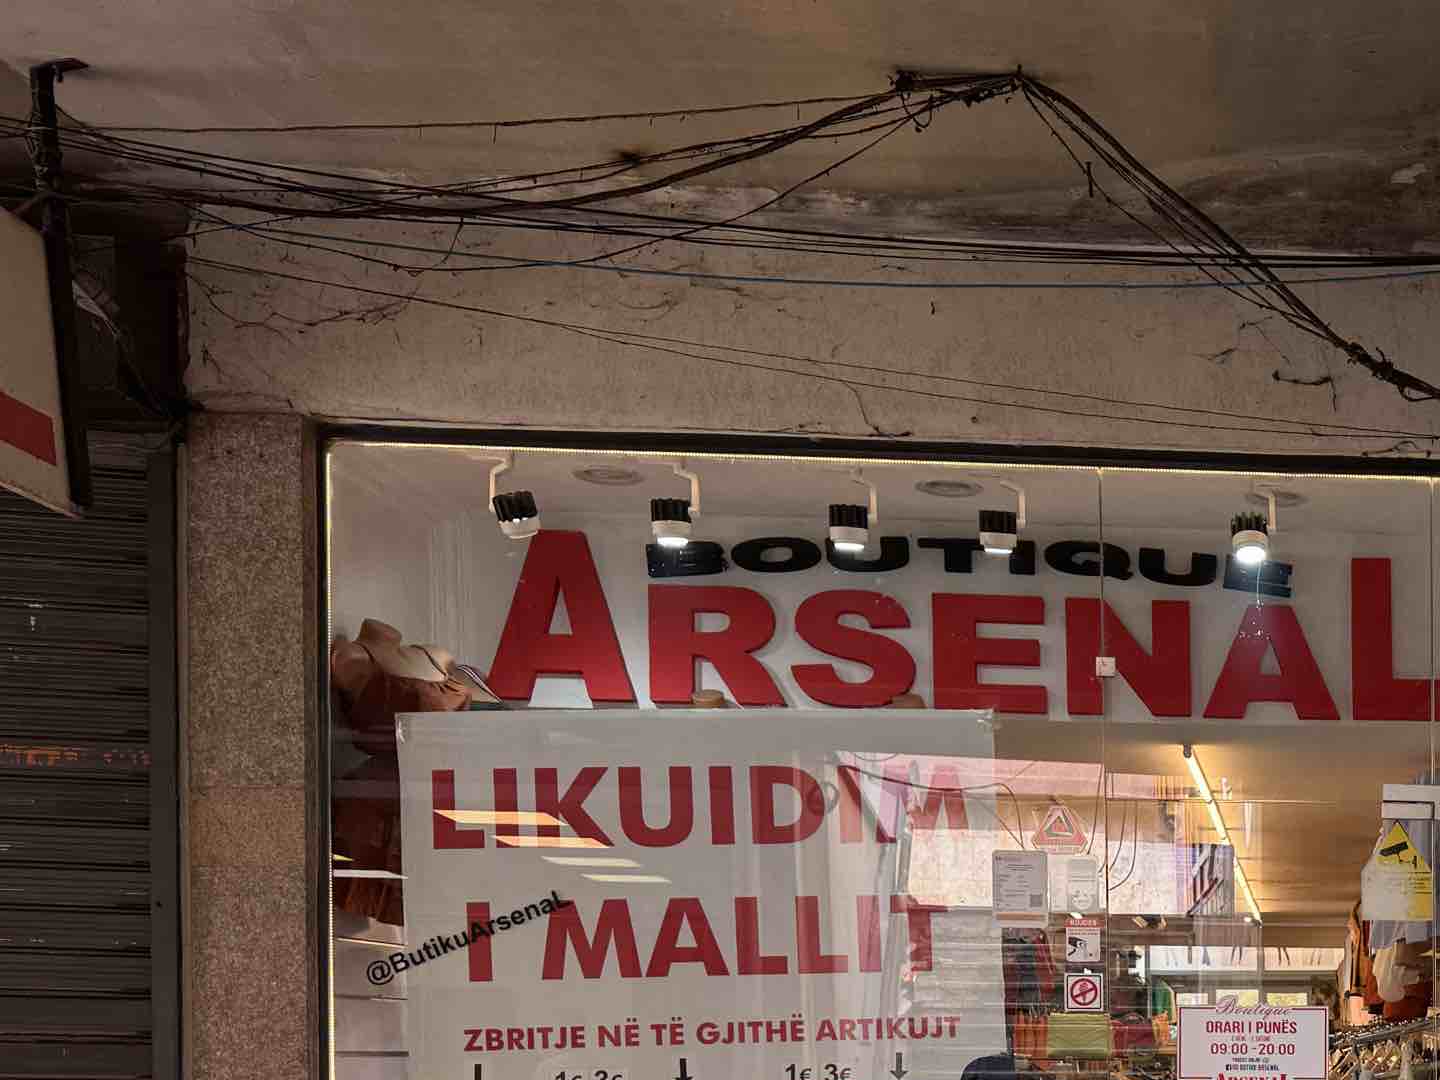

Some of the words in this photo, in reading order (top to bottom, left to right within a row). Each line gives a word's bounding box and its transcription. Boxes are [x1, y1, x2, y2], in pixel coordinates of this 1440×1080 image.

[646, 537, 1292, 598] BOUTIQUE
[431, 764, 969, 850] LIKUIDIM
[465, 901, 494, 982] I
[541, 894, 949, 981] MALLIT
[463, 1025, 586, 1052] ZBRITJE
[597, 1017, 641, 1048] NË
[650, 1016, 686, 1046] TË
[695, 1013, 806, 1045] GJITHË
[815, 1015, 962, 1041] ARTIKUJT
[1206, 1020, 1244, 1034] ORARI
[1256, 1018, 1297, 1034] PUNËS
[1215, 994, 1293, 1021] Boutique
